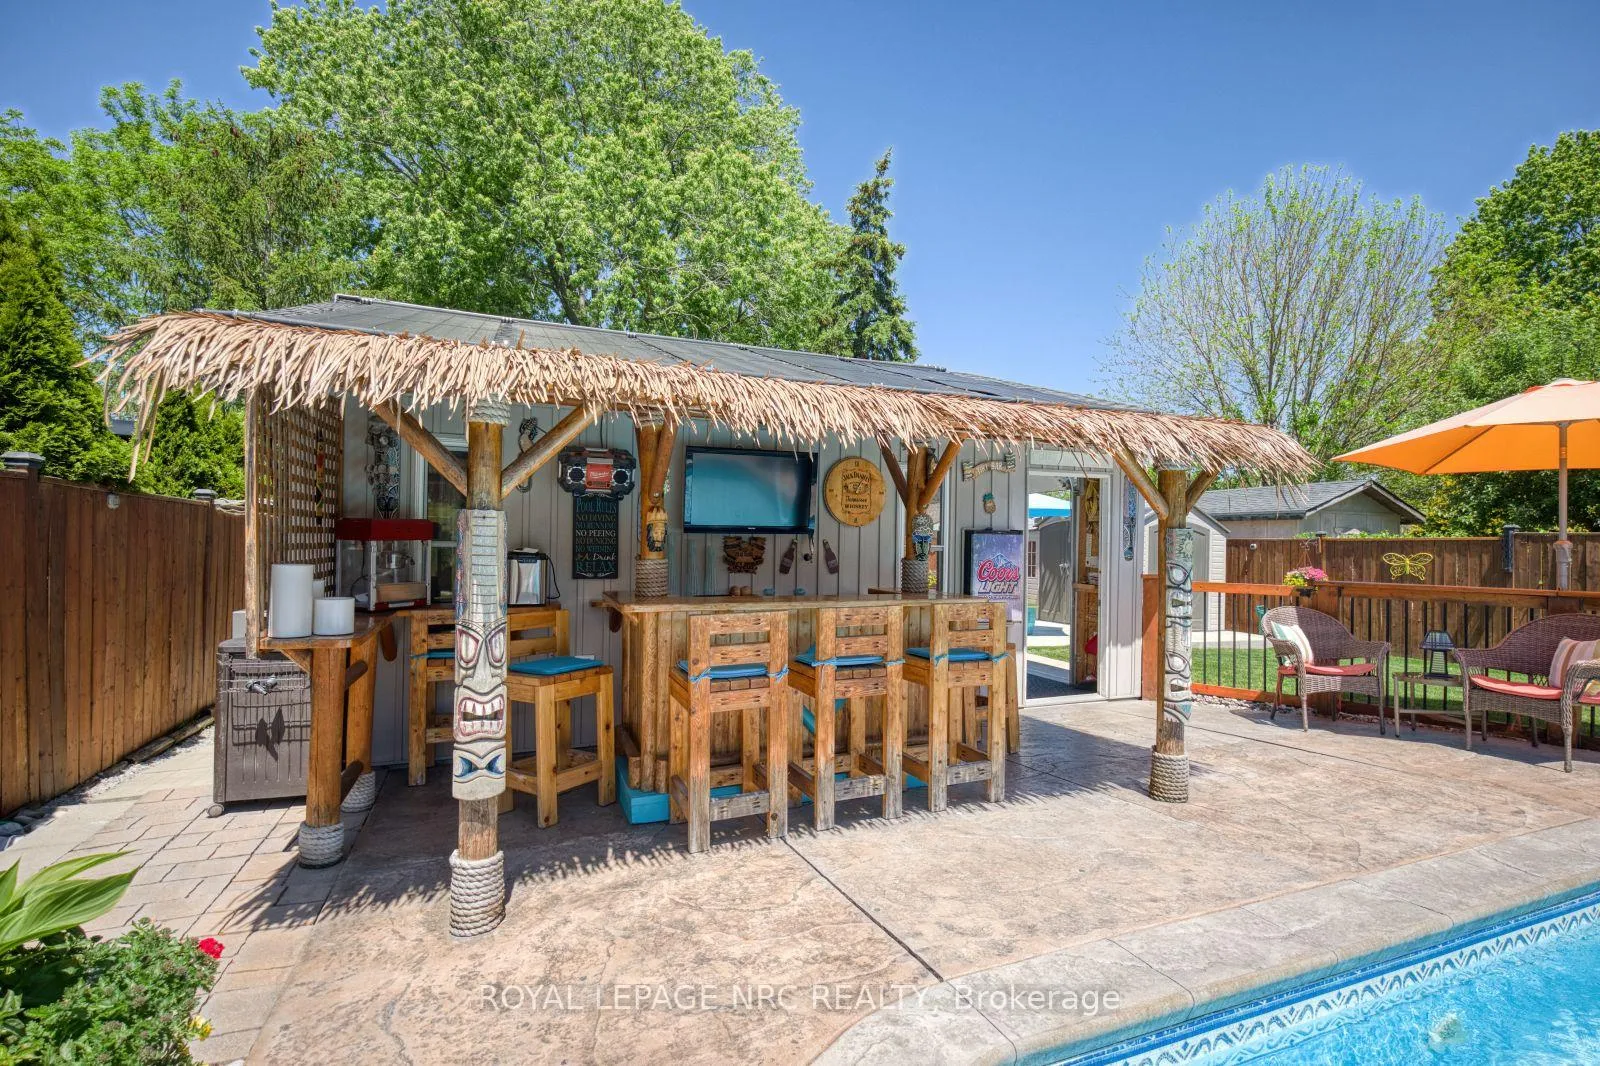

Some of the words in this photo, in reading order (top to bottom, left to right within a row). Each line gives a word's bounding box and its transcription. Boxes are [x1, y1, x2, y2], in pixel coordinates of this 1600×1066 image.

[576, 561, 617, 572] RELAX
[977, 560, 1019, 581] Coors
[978, 581, 1018, 594] LIGHT
